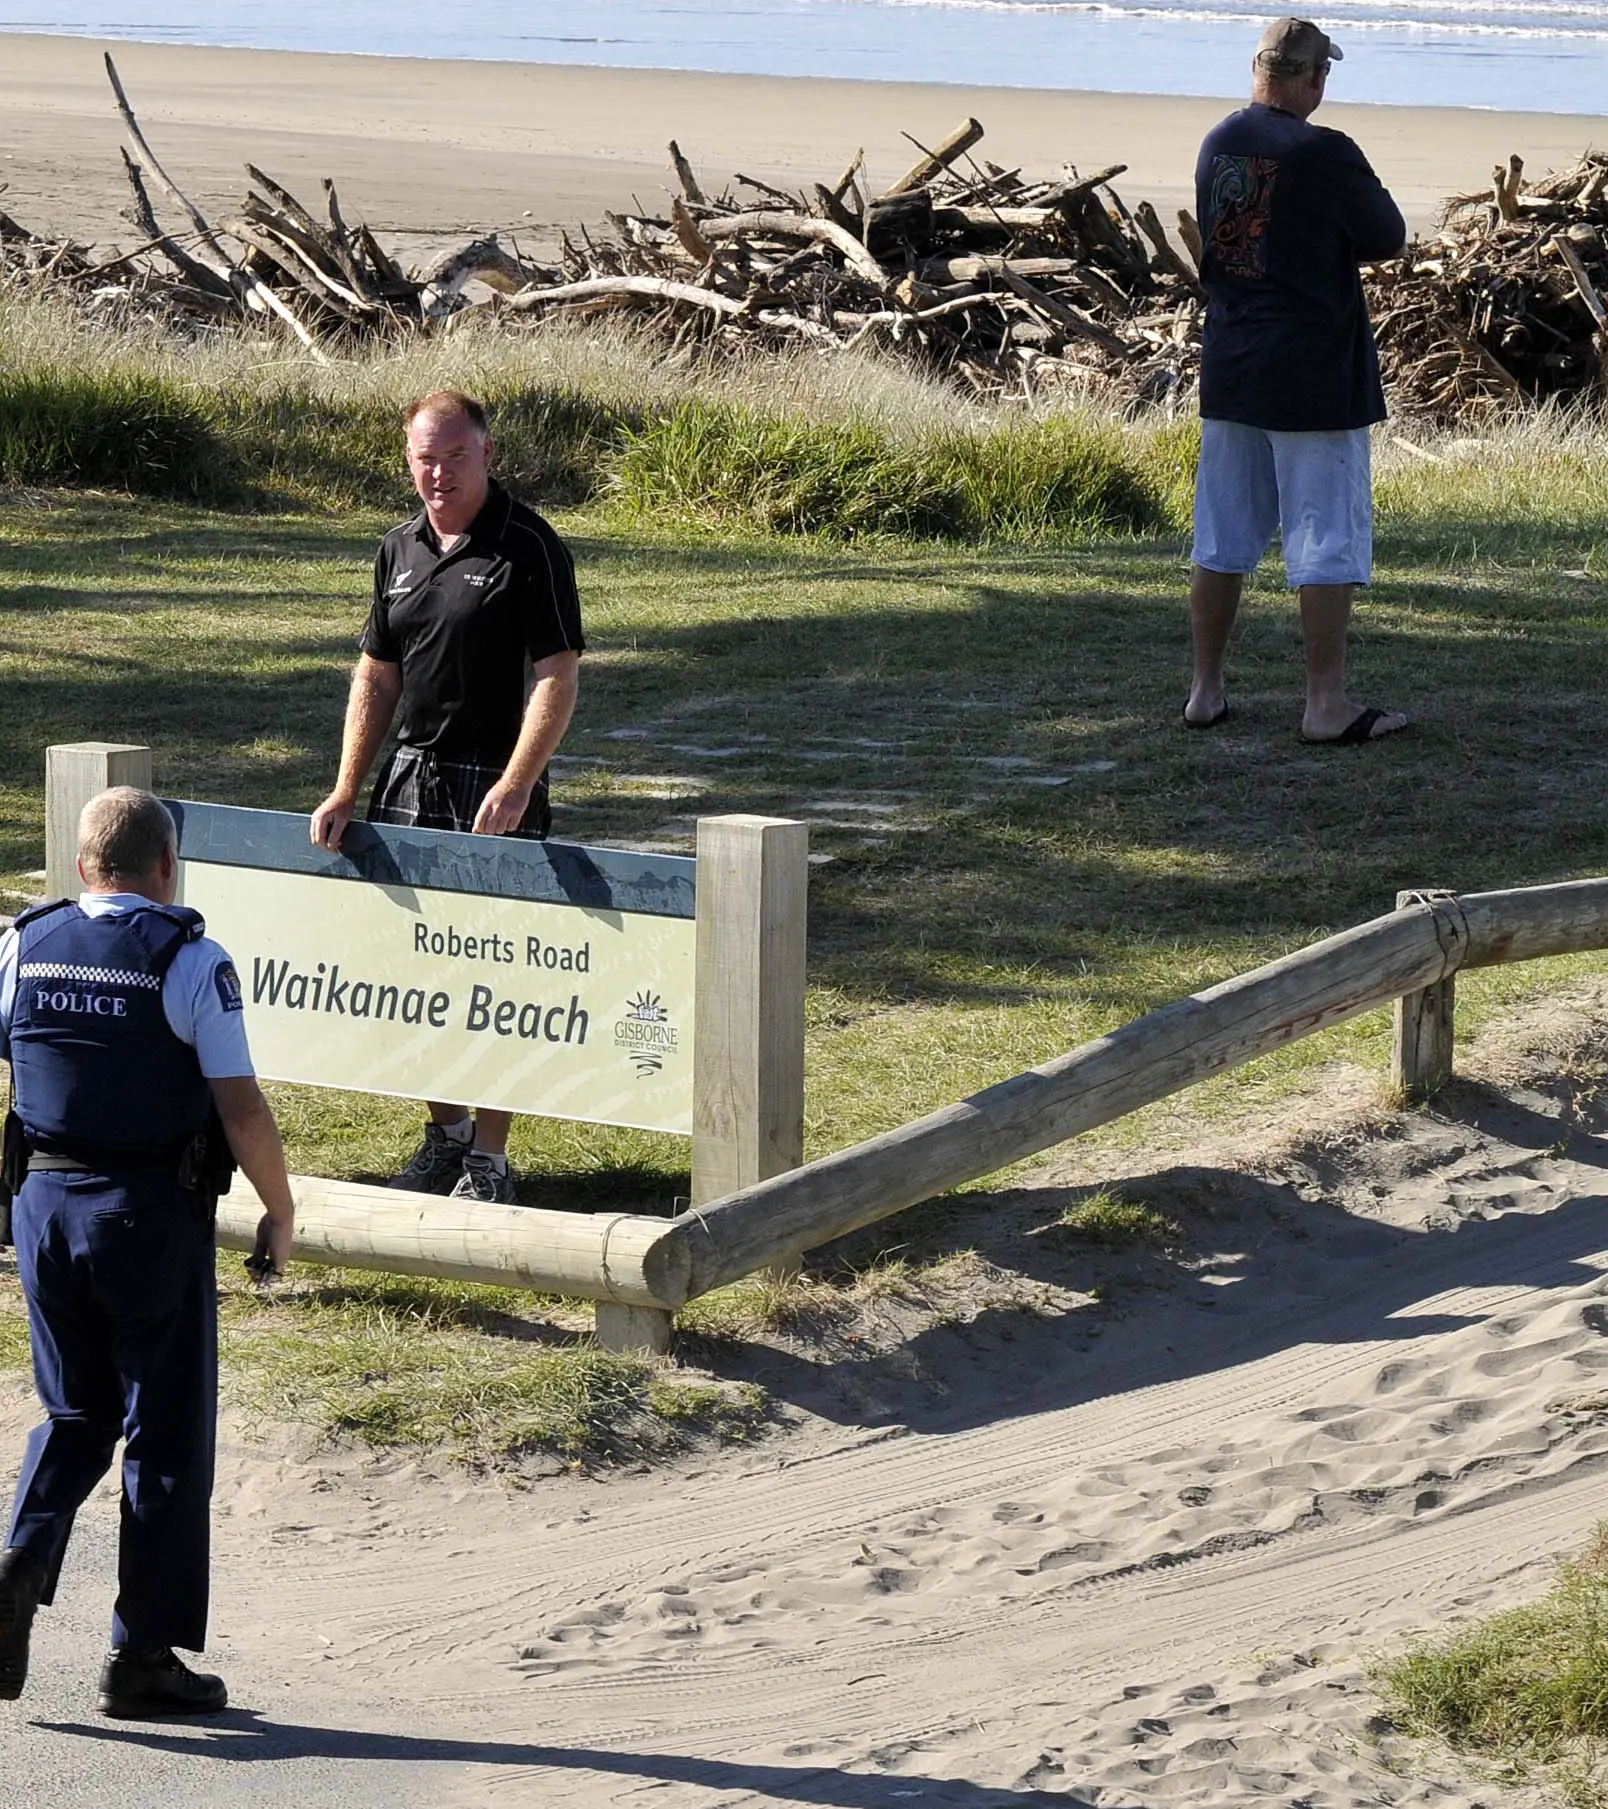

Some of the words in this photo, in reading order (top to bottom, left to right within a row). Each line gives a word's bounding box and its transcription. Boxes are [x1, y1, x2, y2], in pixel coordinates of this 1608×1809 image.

[414, 922, 514, 963] Roberts
[526, 936, 590, 973] Road
[35, 989, 128, 1017] POLICE
[253, 957, 450, 1027] Waikanae
[466, 984, 589, 1044] Beach
[614, 1021, 678, 1045] GISBORNE
[614, 1039, 644, 1049] DISTRICT
[645, 1043, 678, 1053] COUNCIL
